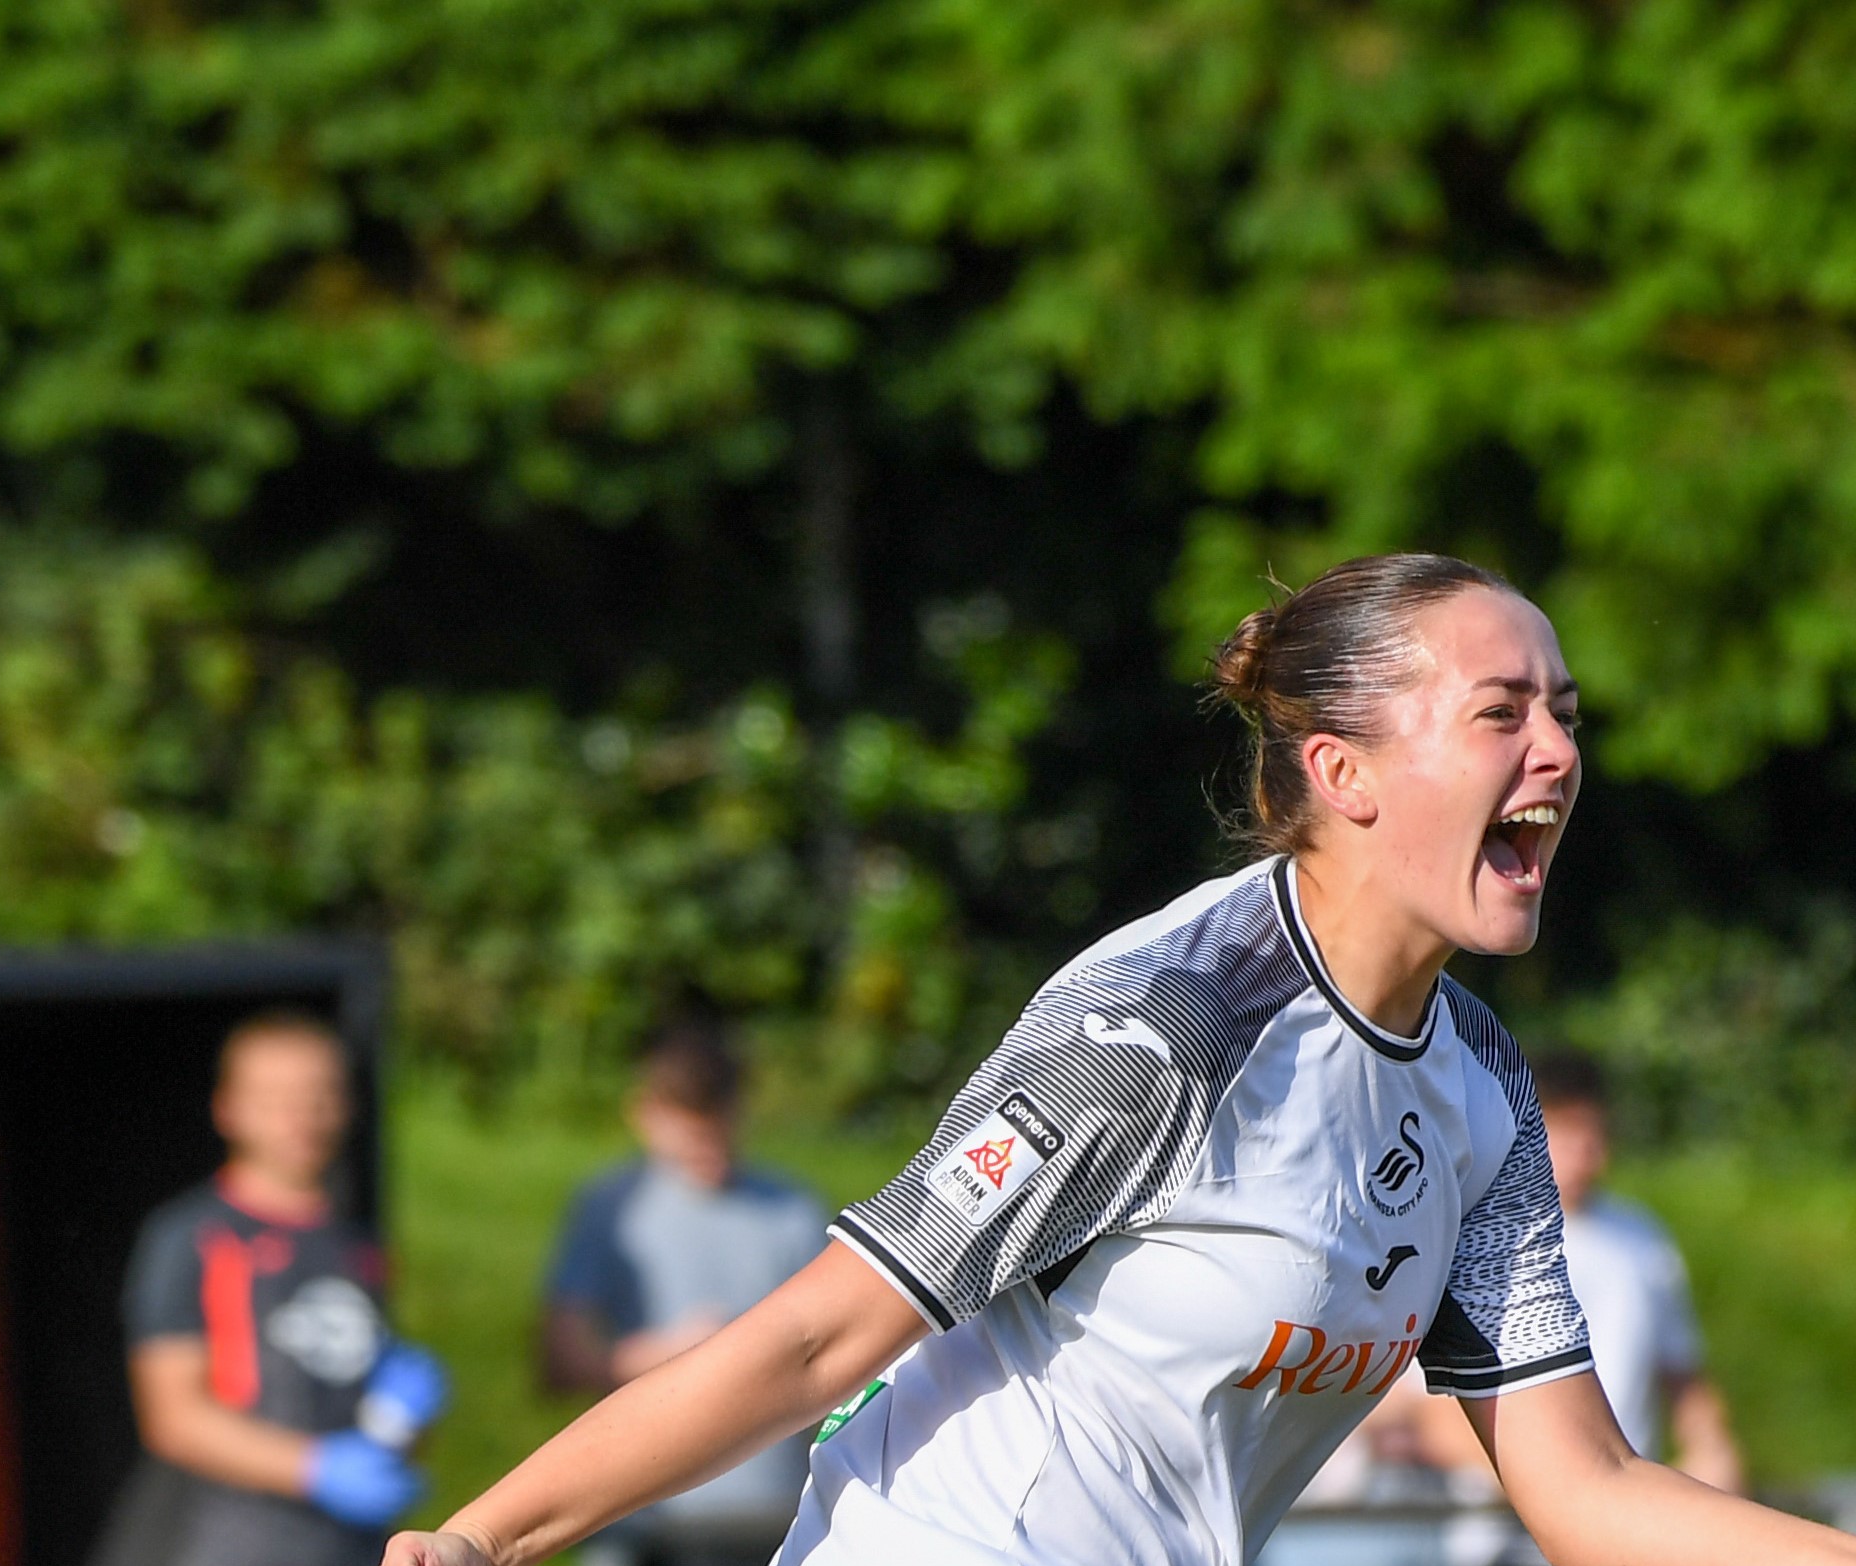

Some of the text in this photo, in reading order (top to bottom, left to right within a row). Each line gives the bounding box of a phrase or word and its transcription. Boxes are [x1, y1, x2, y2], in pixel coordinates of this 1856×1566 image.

[1003, 1099, 1058, 1150] genero
[935, 1172, 981, 1218] PREMIER
[949, 1165, 988, 1202] ADRAN
[1397, 1197, 1416, 1217] CITY
